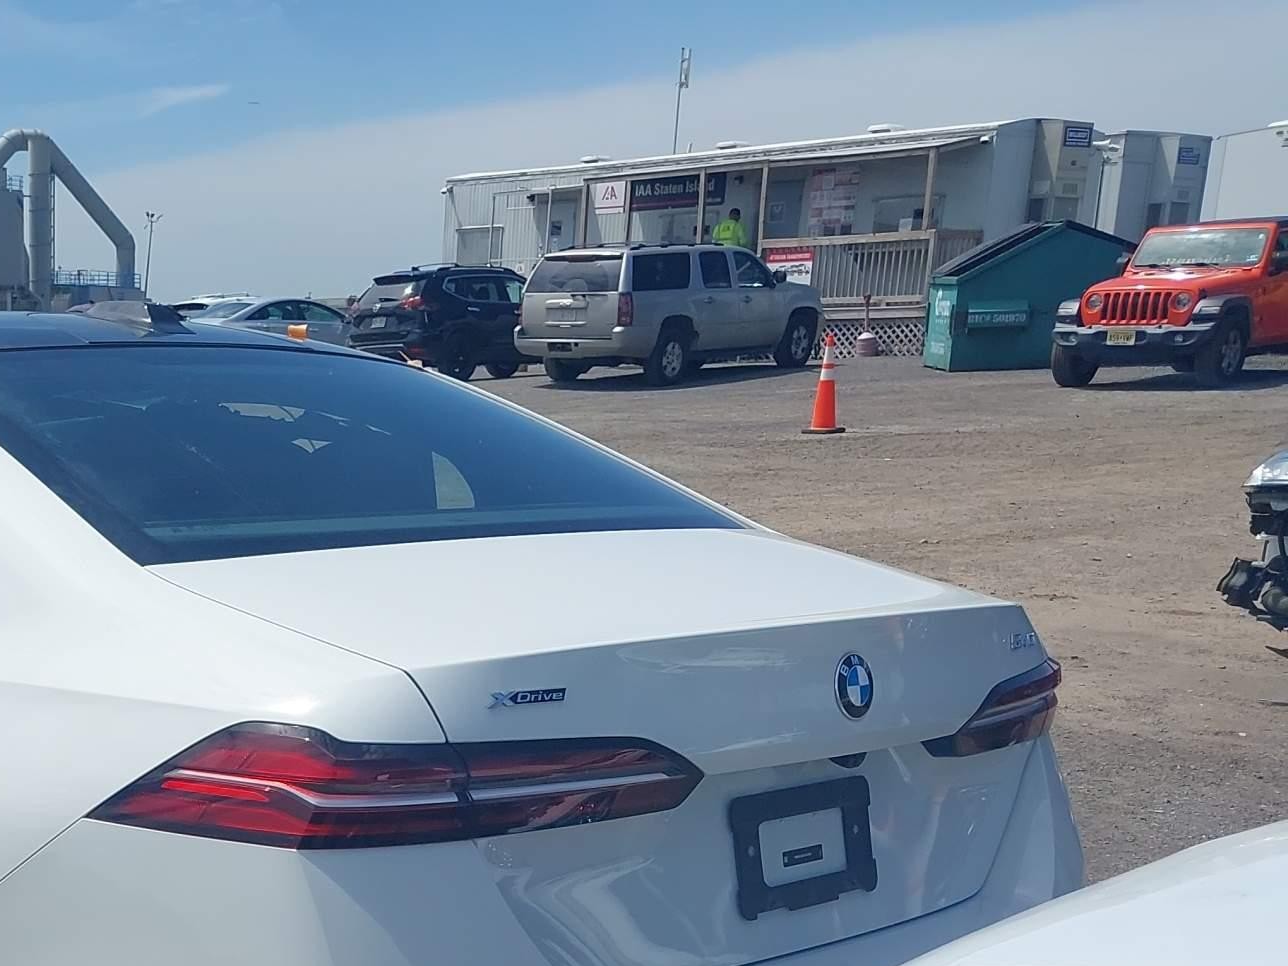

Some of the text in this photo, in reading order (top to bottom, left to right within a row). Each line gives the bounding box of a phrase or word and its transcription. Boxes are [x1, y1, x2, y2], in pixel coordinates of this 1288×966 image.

[635, 177, 715, 197] IAA Staten Isld
